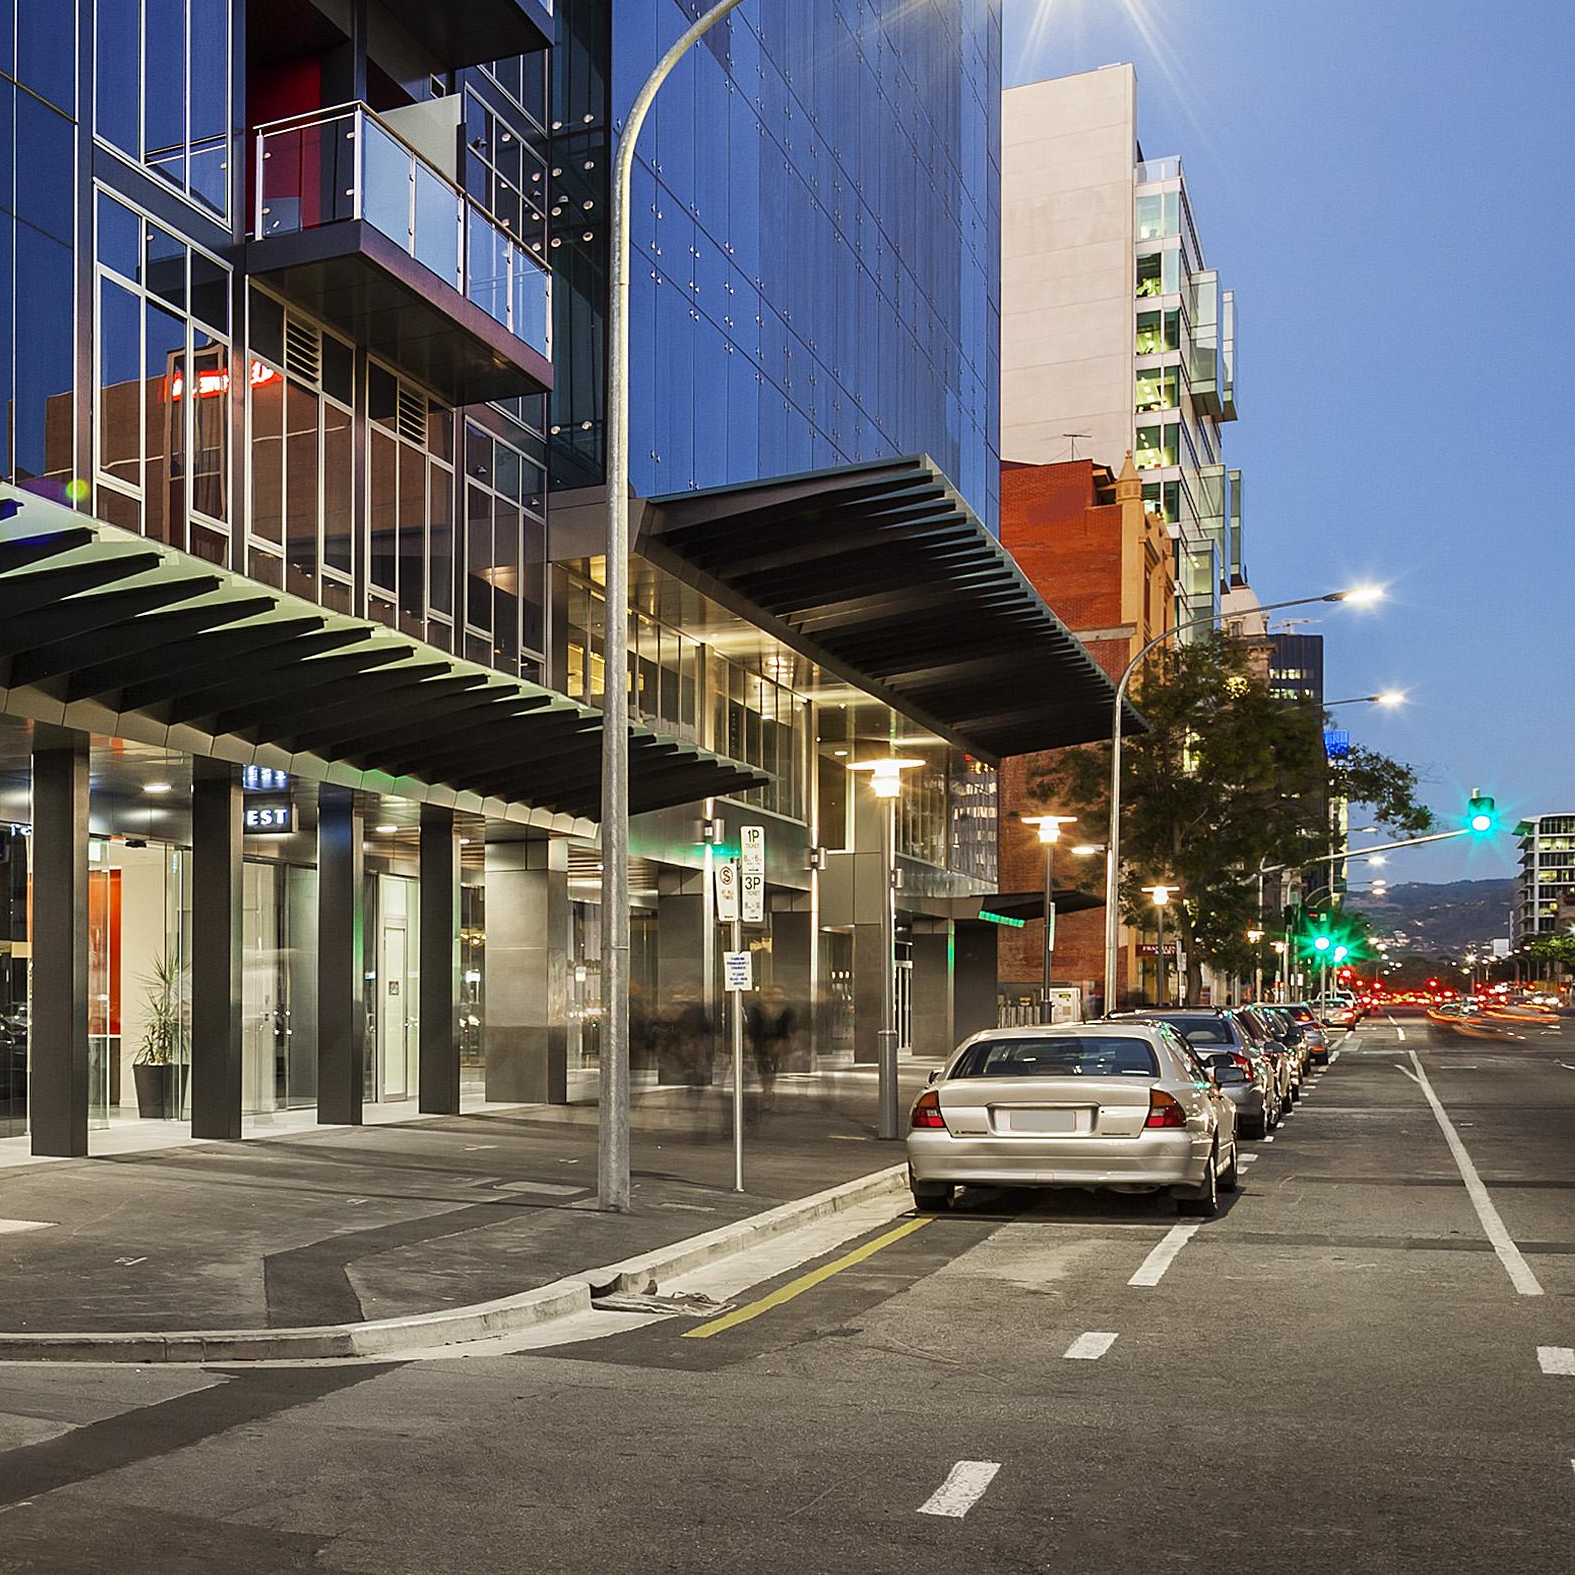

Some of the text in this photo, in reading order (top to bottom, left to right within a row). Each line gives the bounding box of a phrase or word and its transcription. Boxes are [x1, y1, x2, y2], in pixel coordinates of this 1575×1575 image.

[243, 809, 288, 826] EST
[747, 829, 760, 842] 1P
[745, 876, 761, 890] 3P
